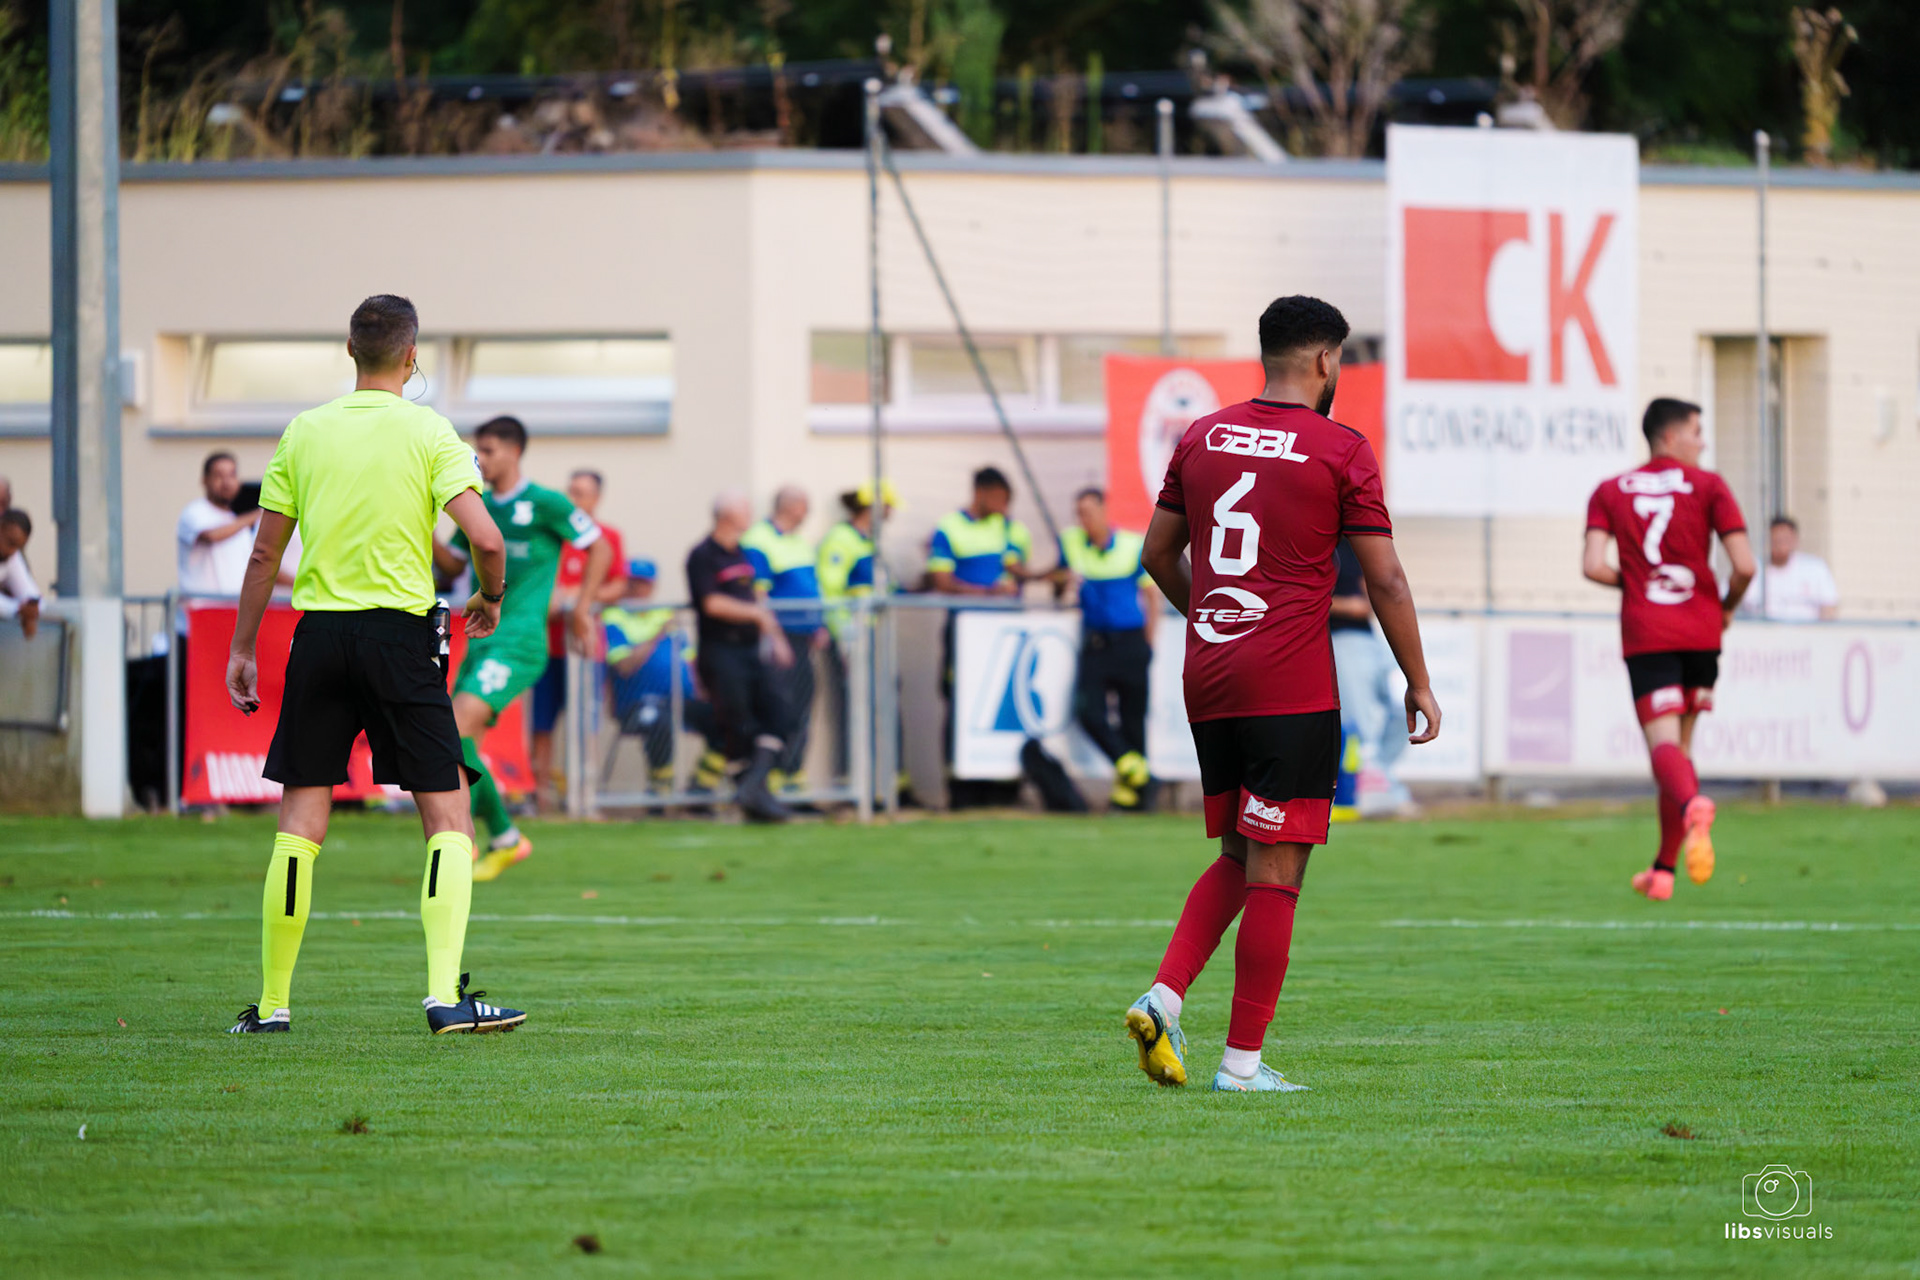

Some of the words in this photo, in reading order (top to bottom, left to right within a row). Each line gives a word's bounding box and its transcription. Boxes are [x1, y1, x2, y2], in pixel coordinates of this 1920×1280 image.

[1403, 207, 1618, 386] CK
[1204, 423, 1310, 463] GBBL
[1399, 402, 1534, 453] CONRAD
[1544, 404, 1627, 453] KERN
[1208, 471, 1261, 577] 6
[1632, 494, 1675, 565] 7
[1195, 608, 1266, 624] TES
